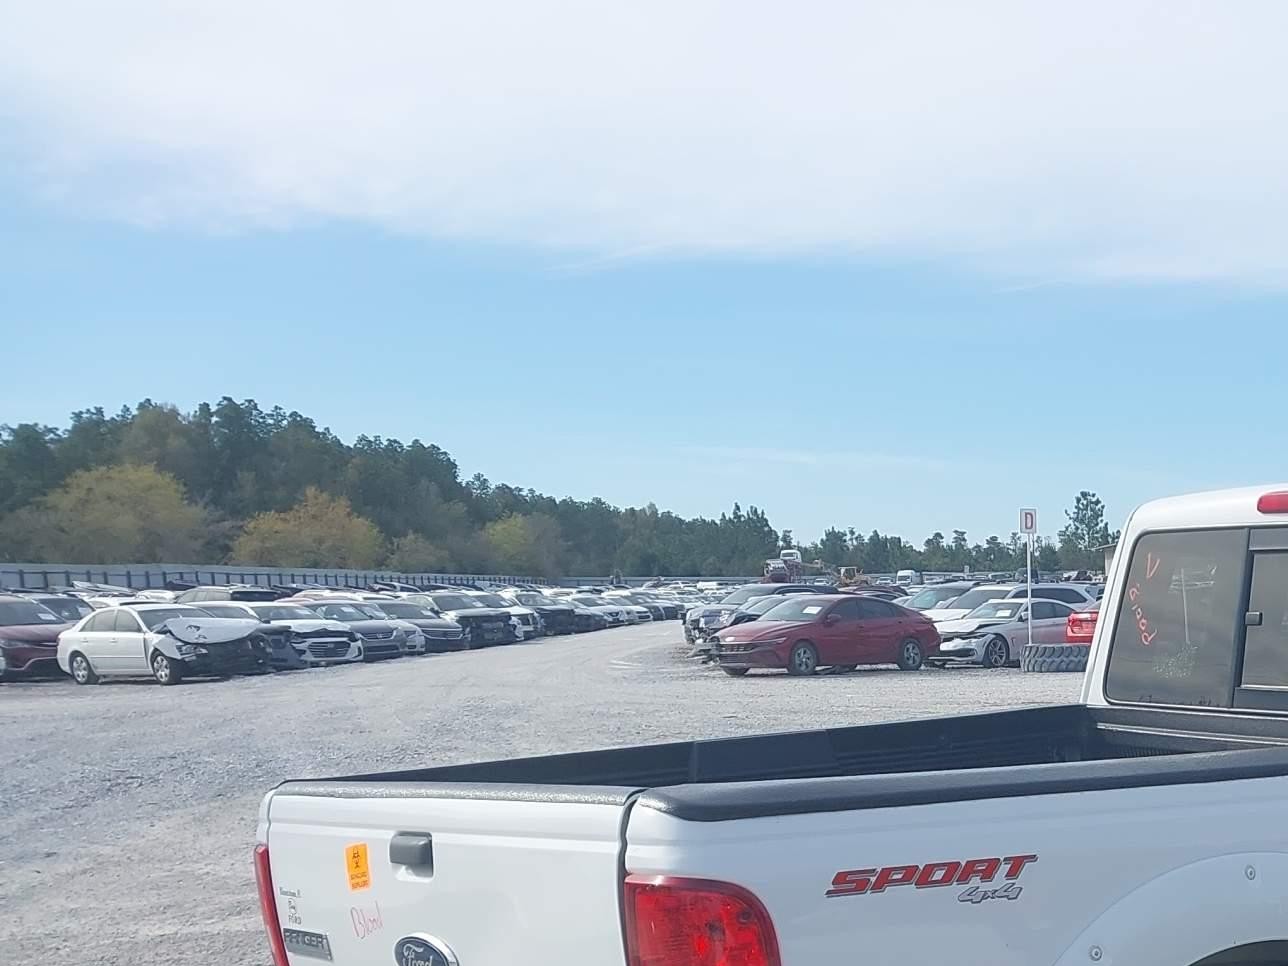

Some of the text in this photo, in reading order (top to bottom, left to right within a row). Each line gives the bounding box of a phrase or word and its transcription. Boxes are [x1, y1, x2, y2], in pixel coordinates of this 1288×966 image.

[1024, 511, 1034, 530] D
[825, 854, 1039, 898] SPORT
[957, 883, 1023, 904] 4x4
[350, 900, 384, 940] Blood
